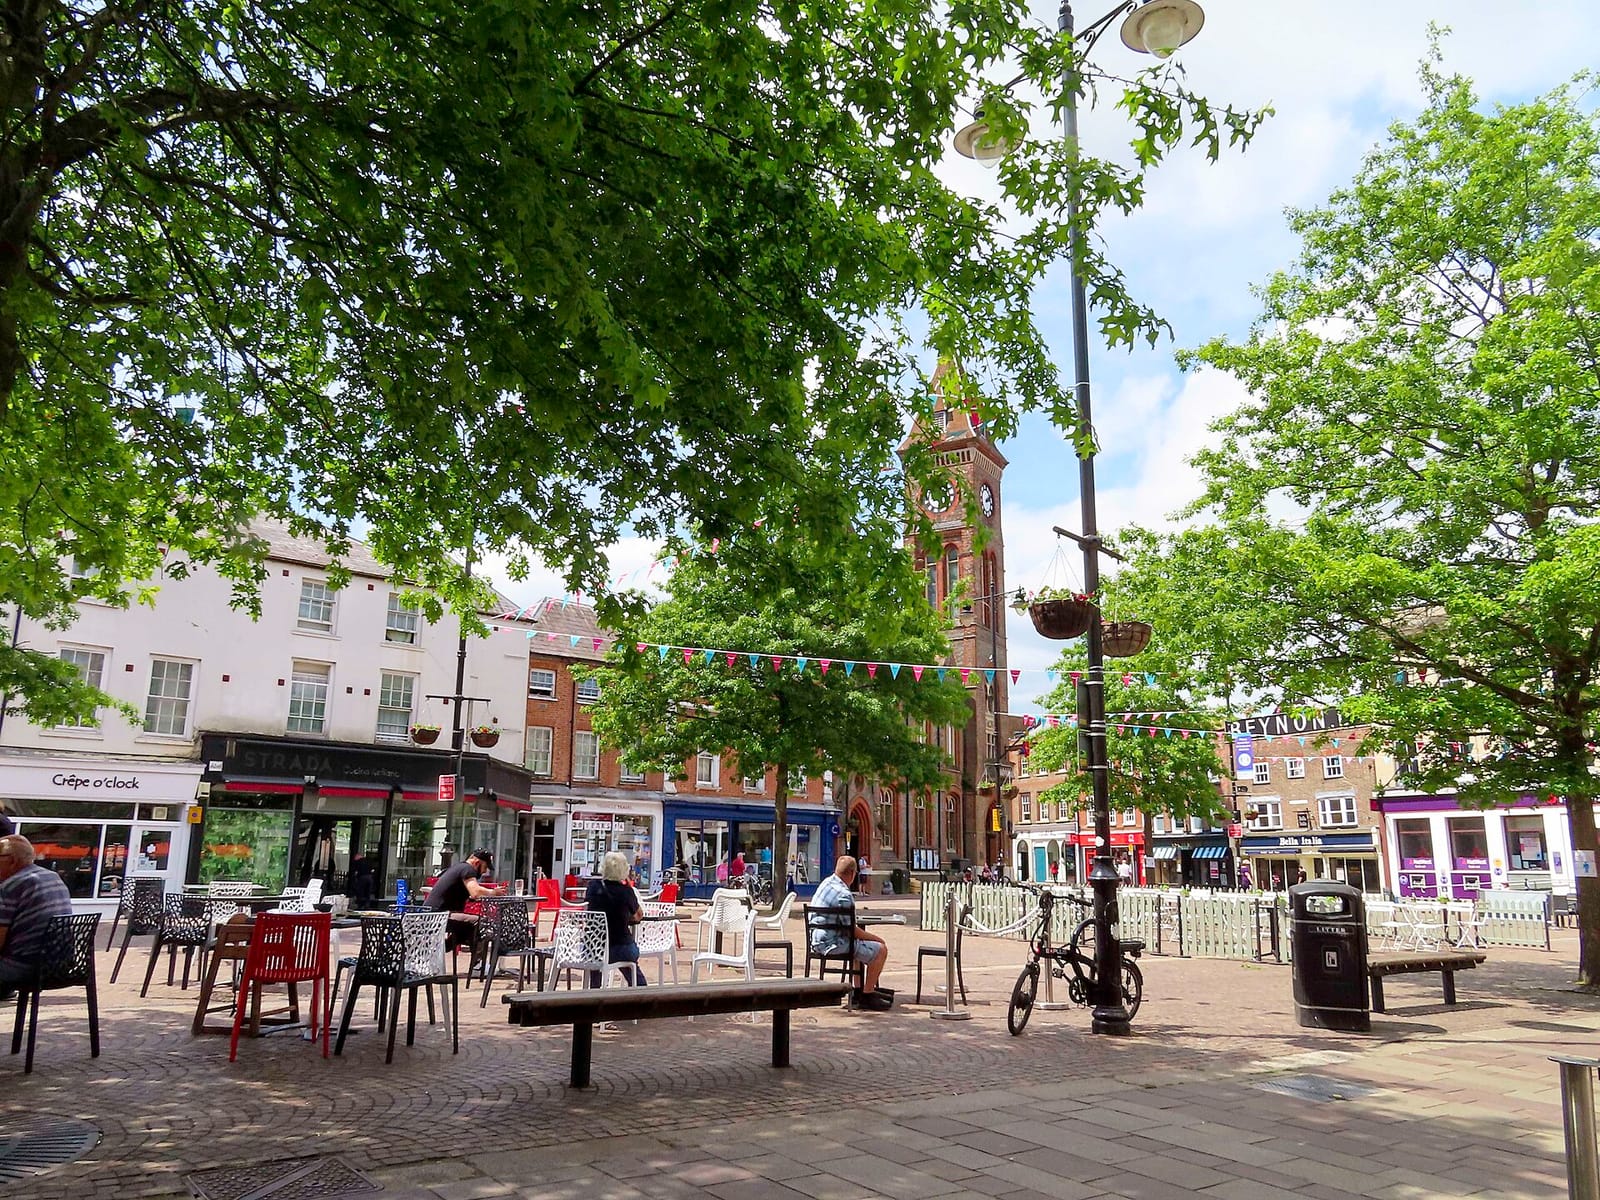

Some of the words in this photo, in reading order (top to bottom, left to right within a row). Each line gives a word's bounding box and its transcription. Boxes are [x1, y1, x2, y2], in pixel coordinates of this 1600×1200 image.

[244, 752, 333, 773] STRADA
[52, 774, 90, 790] Crêpe
[1279, 837, 1299, 846] Bella
[1301, 836, 1323, 845] Italia
